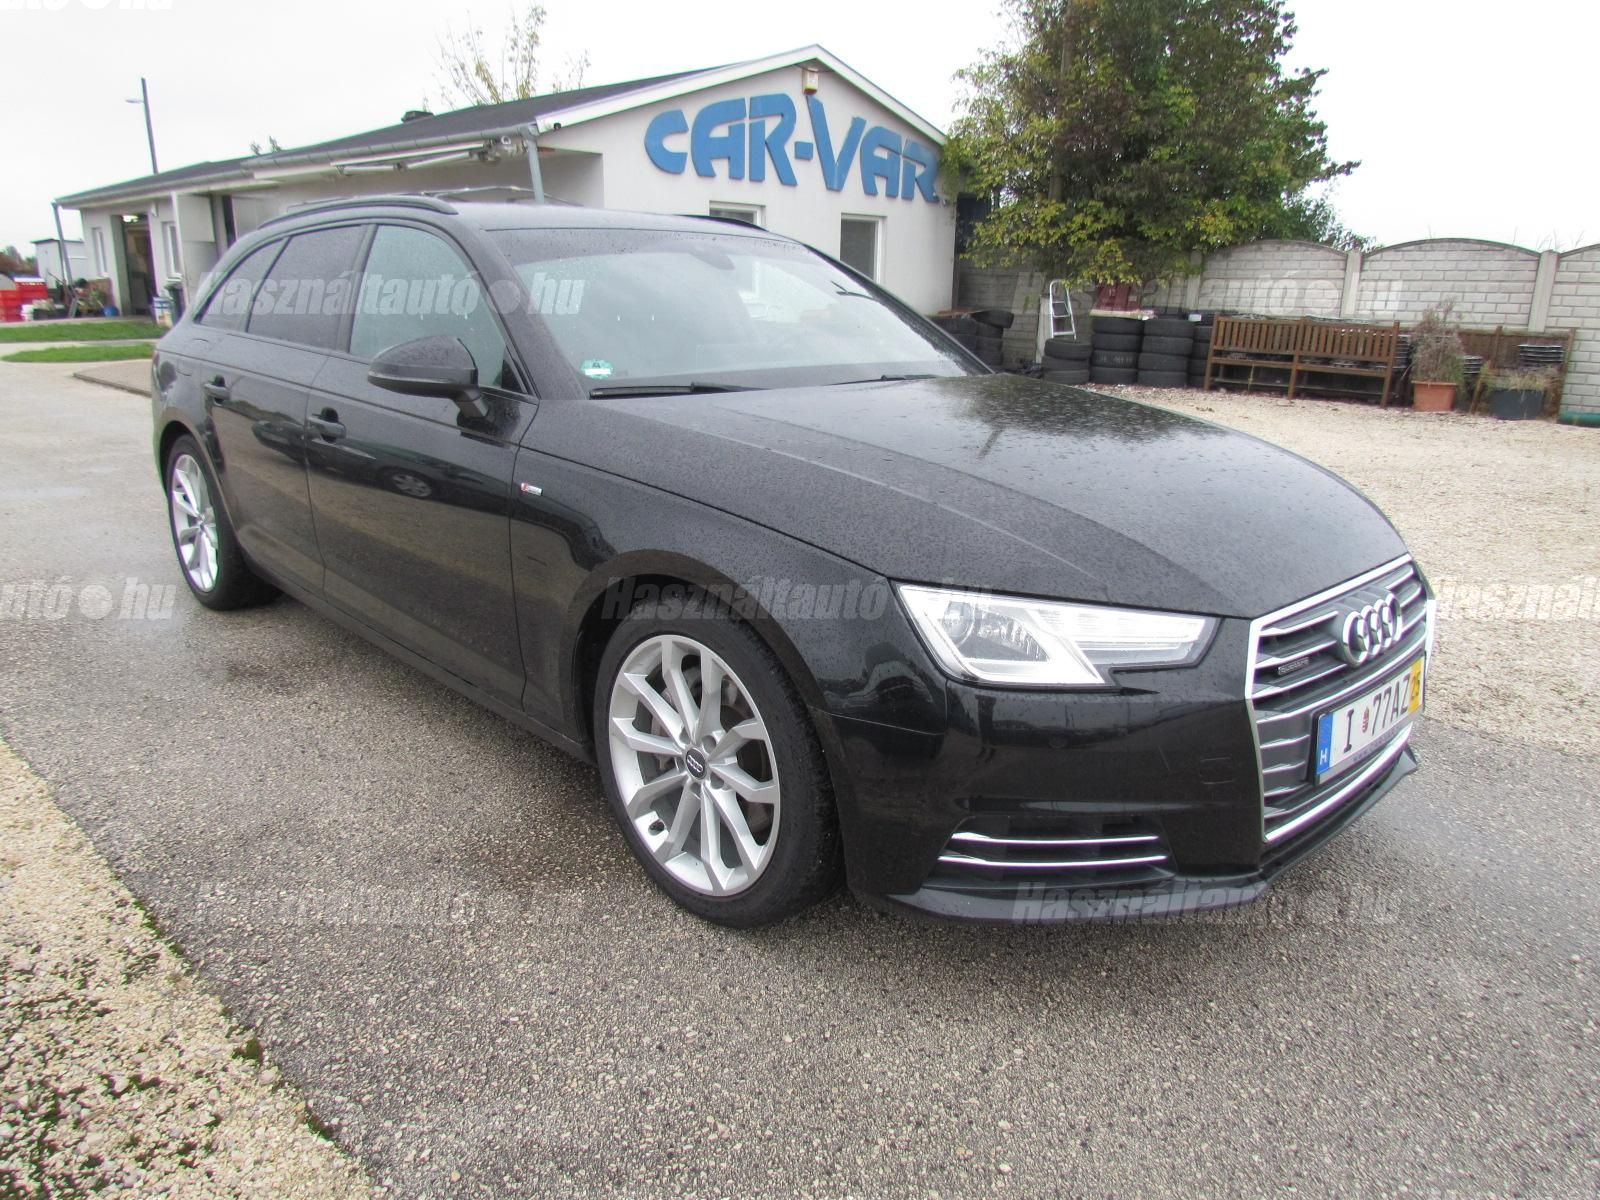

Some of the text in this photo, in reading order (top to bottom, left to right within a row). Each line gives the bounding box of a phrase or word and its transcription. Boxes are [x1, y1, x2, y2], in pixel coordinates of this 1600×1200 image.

[644, 93, 939, 203] CAR-VAR
[1371, 672, 1411, 737] 77AZ
[1319, 747, 1328, 766] H
